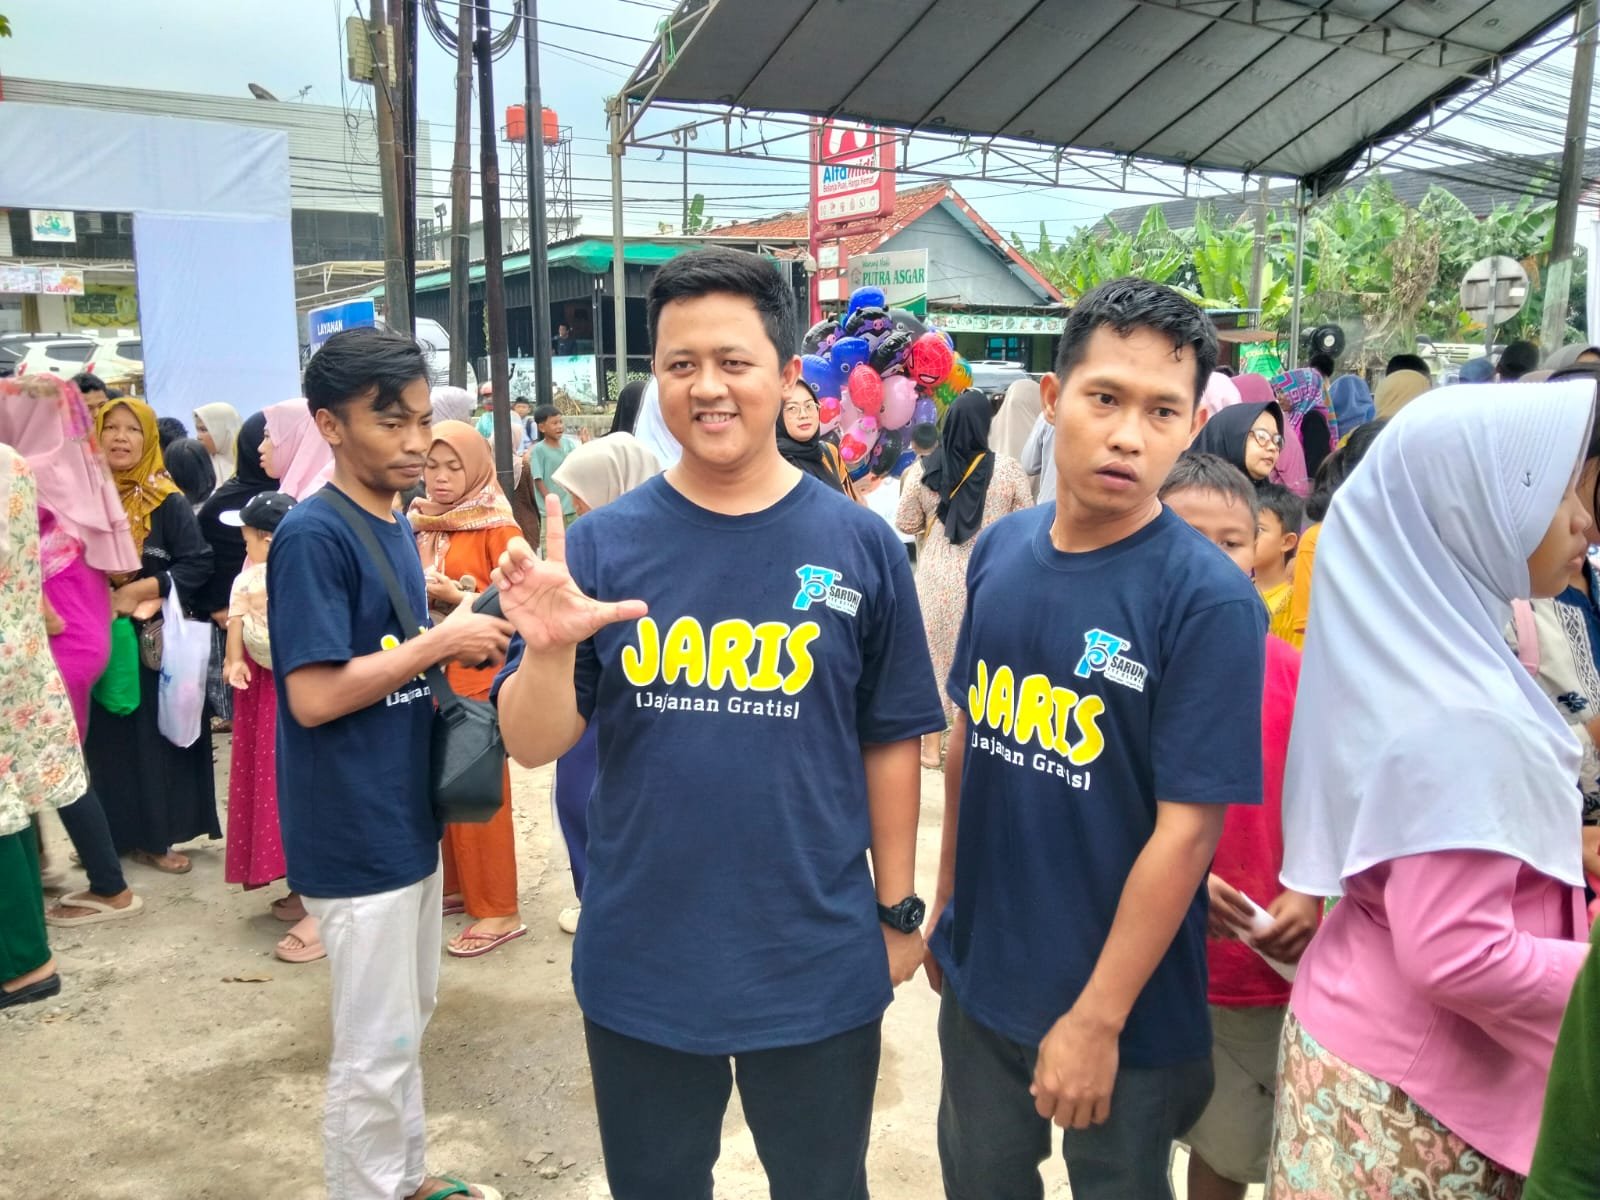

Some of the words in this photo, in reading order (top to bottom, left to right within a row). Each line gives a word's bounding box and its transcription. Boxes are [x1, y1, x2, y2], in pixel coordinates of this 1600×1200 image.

[863, 270, 891, 287] PUTRA
[894, 268, 925, 285] ASGAR
[317, 320, 343, 336] LAYANAN
[622, 616, 820, 695] JARIS
[968, 659, 1105, 766] JARIS
